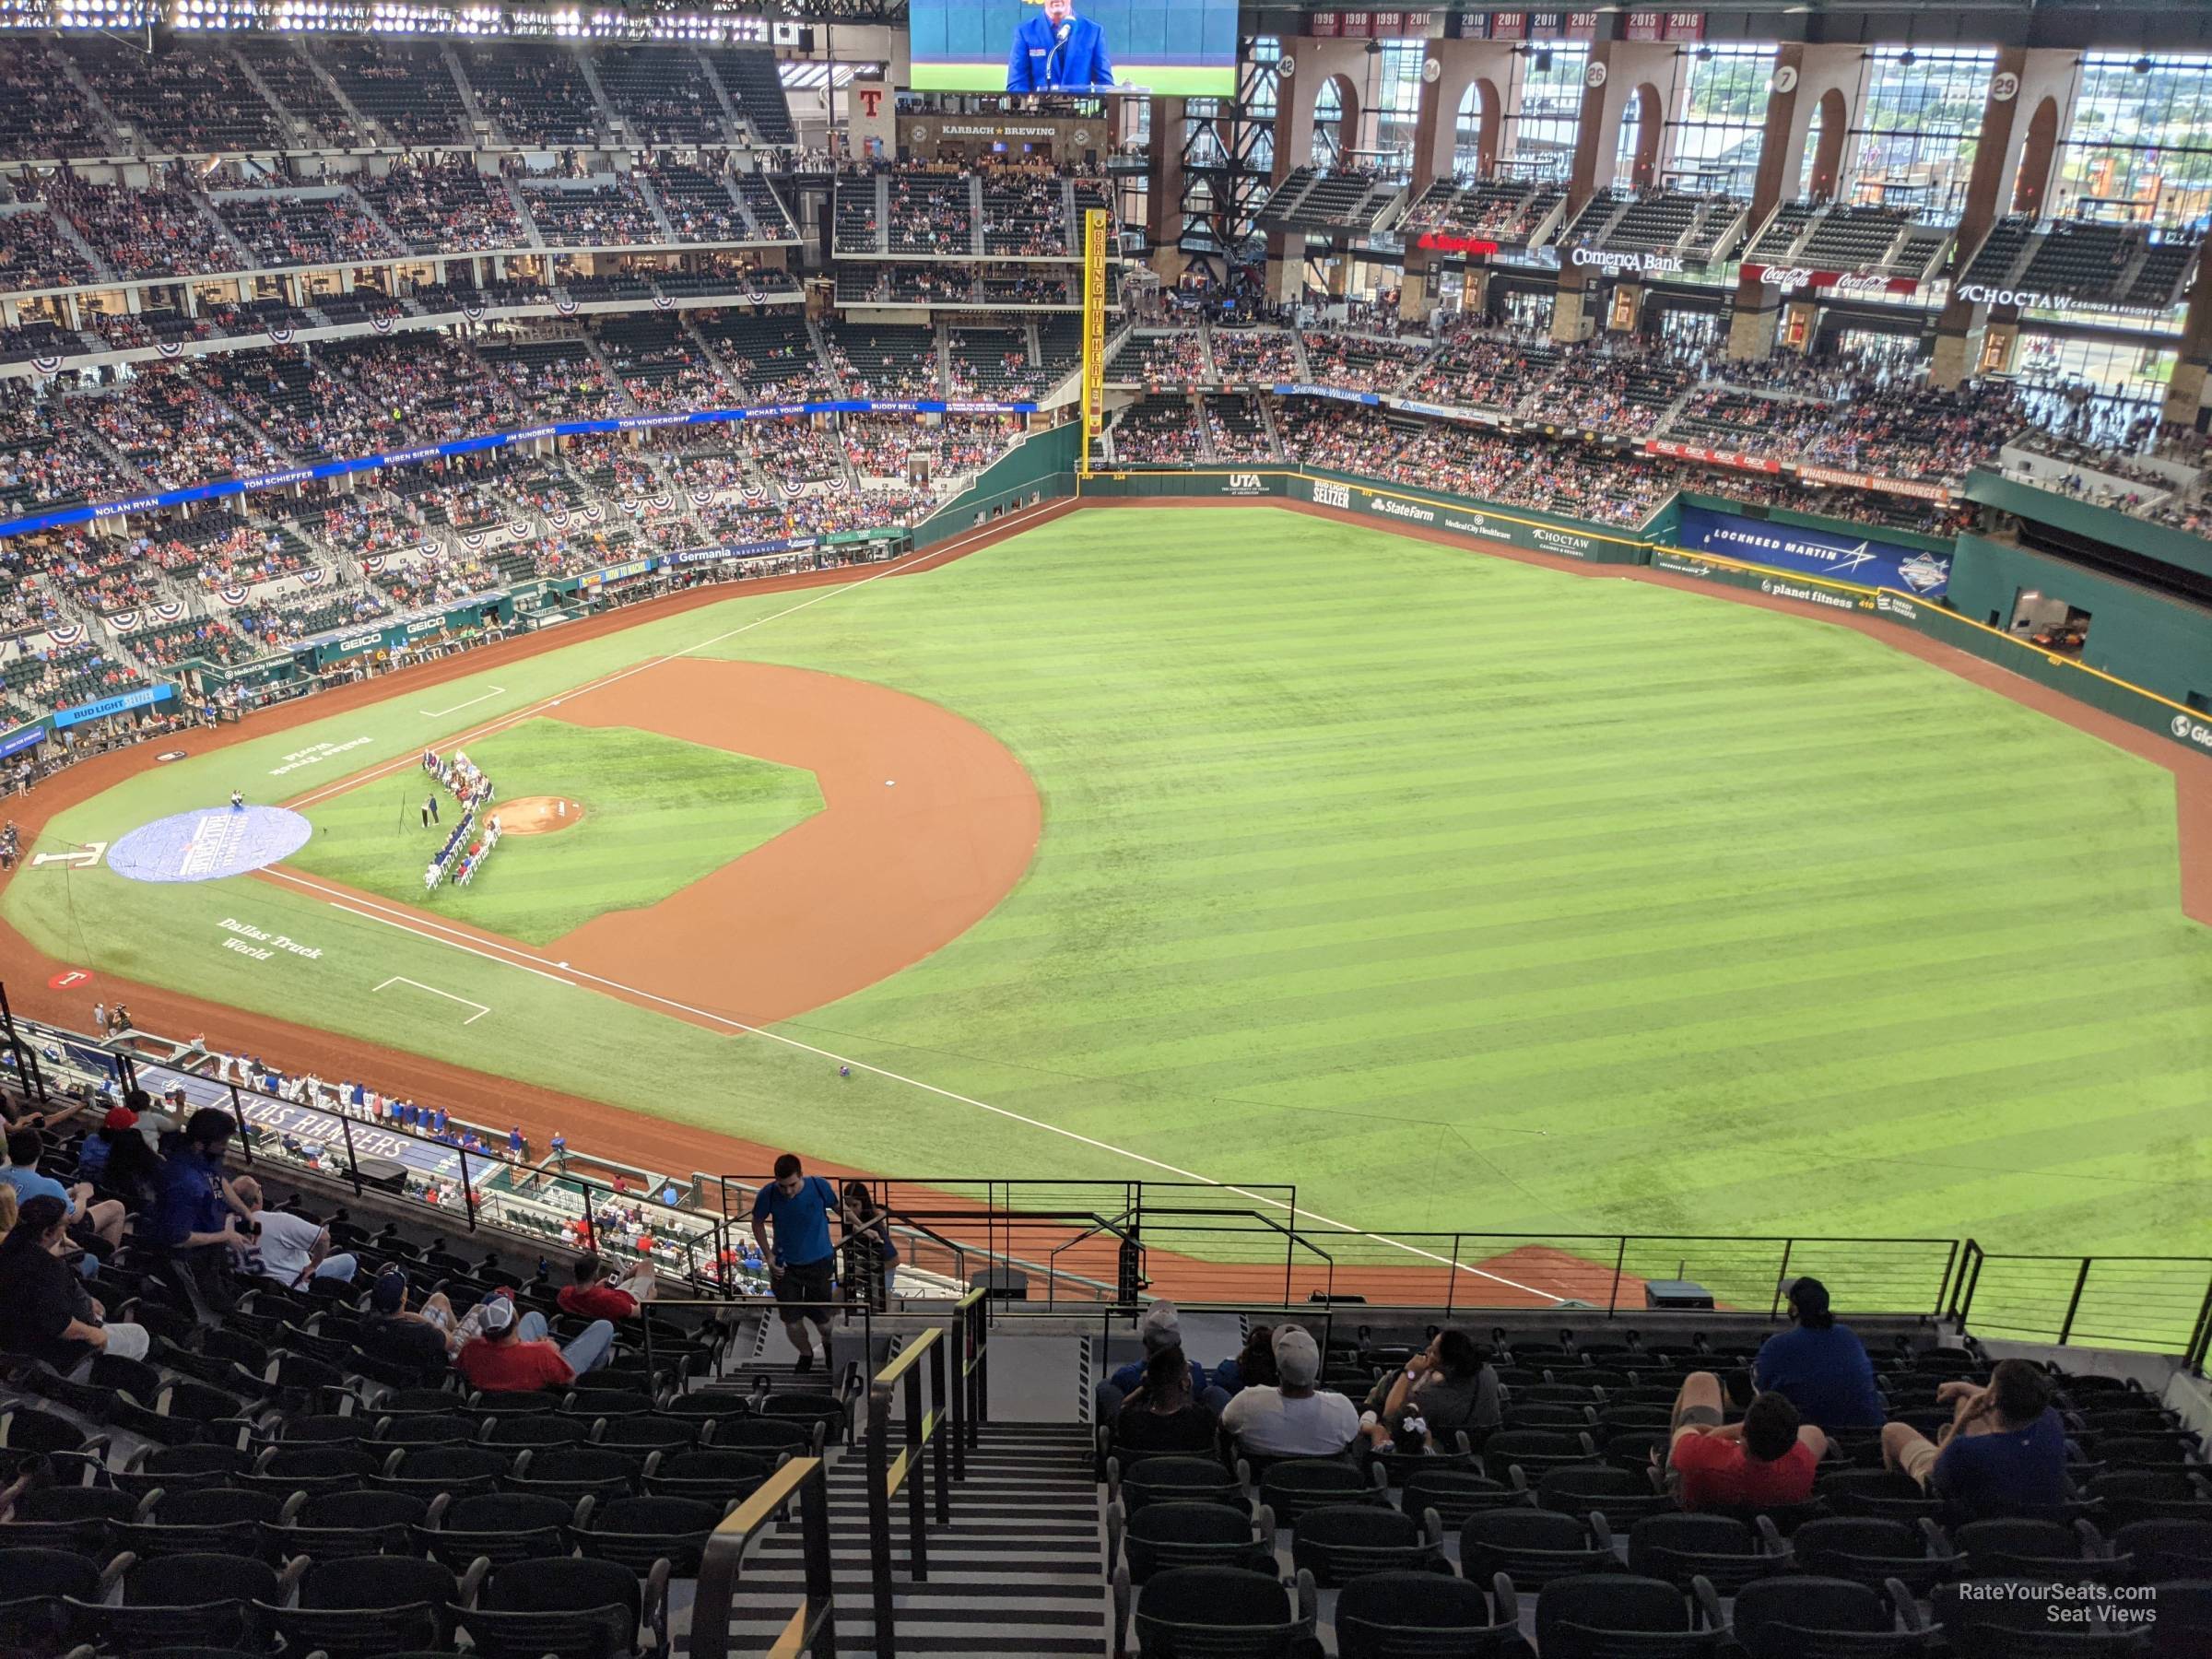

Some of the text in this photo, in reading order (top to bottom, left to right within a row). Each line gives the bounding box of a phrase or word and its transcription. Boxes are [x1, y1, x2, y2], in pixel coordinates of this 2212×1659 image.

[1313, 13, 1335, 24] 1996
[1345, 13, 1367, 25] 1998
[1376, 13, 1399, 25] 1999
[1462, 14, 1484, 26] 2010
[1498, 14, 1521, 26] 2011
[1534, 14, 1557, 27] 2011
[1571, 14, 1597, 27] 2012
[1630, 14, 1657, 27] 2015
[1670, 14, 1699, 27] 2016
[1280, 60, 1293, 73] 42
[1587, 67, 1604, 82] 26
[1781, 72, 1791, 88] 7
[1994, 78, 2015, 95] 29
[859, 89, 883, 118] T
[942, 125, 1056, 135] KARBACH BREWING
[1093, 230, 1103, 294] BRING
[1643, 253, 1685, 272] Bank
[1968, 286, 2073, 310] CHOCTAW
[1092, 300, 1102, 335] THE
[1091, 339, 1102, 387] HEAT
[746, 408, 778, 417] MICHAEL
[618, 416, 690, 427] TOM VANDERGRIFF
[505, 428, 556, 442] JIM SUNDBERG
[384, 448, 440, 465] RUBEN SIERRA
[1656, 441, 1677, 452] DEX
[1685, 447, 1706, 457] DEX
[1713, 452, 1735, 462] DEX
[1744, 457, 1766, 466] DEX
[244, 471, 313, 489] TOM SCHIEFFER
[1230, 474, 1262, 488] UTA
[1314, 480, 1349, 492] BUD LIGHT
[1800, 467, 1944, 500] WHATABURGER WHATABURGER
[1313, 487, 1349, 509] SELTZER
[95, 499, 159, 516] NOLAN RYAN
[1538, 529, 1589, 548] CHOCTAW
[1713, 528, 1837, 561] LOCKHEED MARTIN
[679, 547, 731, 562] Germania
[1771, 584, 1853, 608] planet fitness
[1858, 600, 1875, 609] 410
[1891, 605, 1916, 619] TRANSFER
[407, 616, 446, 634] GEICO
[340, 632, 382, 652] GEICO
[74, 689, 154, 720] BUD LIGHT SELTZER
[31, 841, 109, 867] T
[216, 918, 324, 959] Dallas Truck
[221, 937, 275, 960] World
[58, 971, 88, 985] T
[211, 1090, 411, 1158] TEXAS RANGERS
